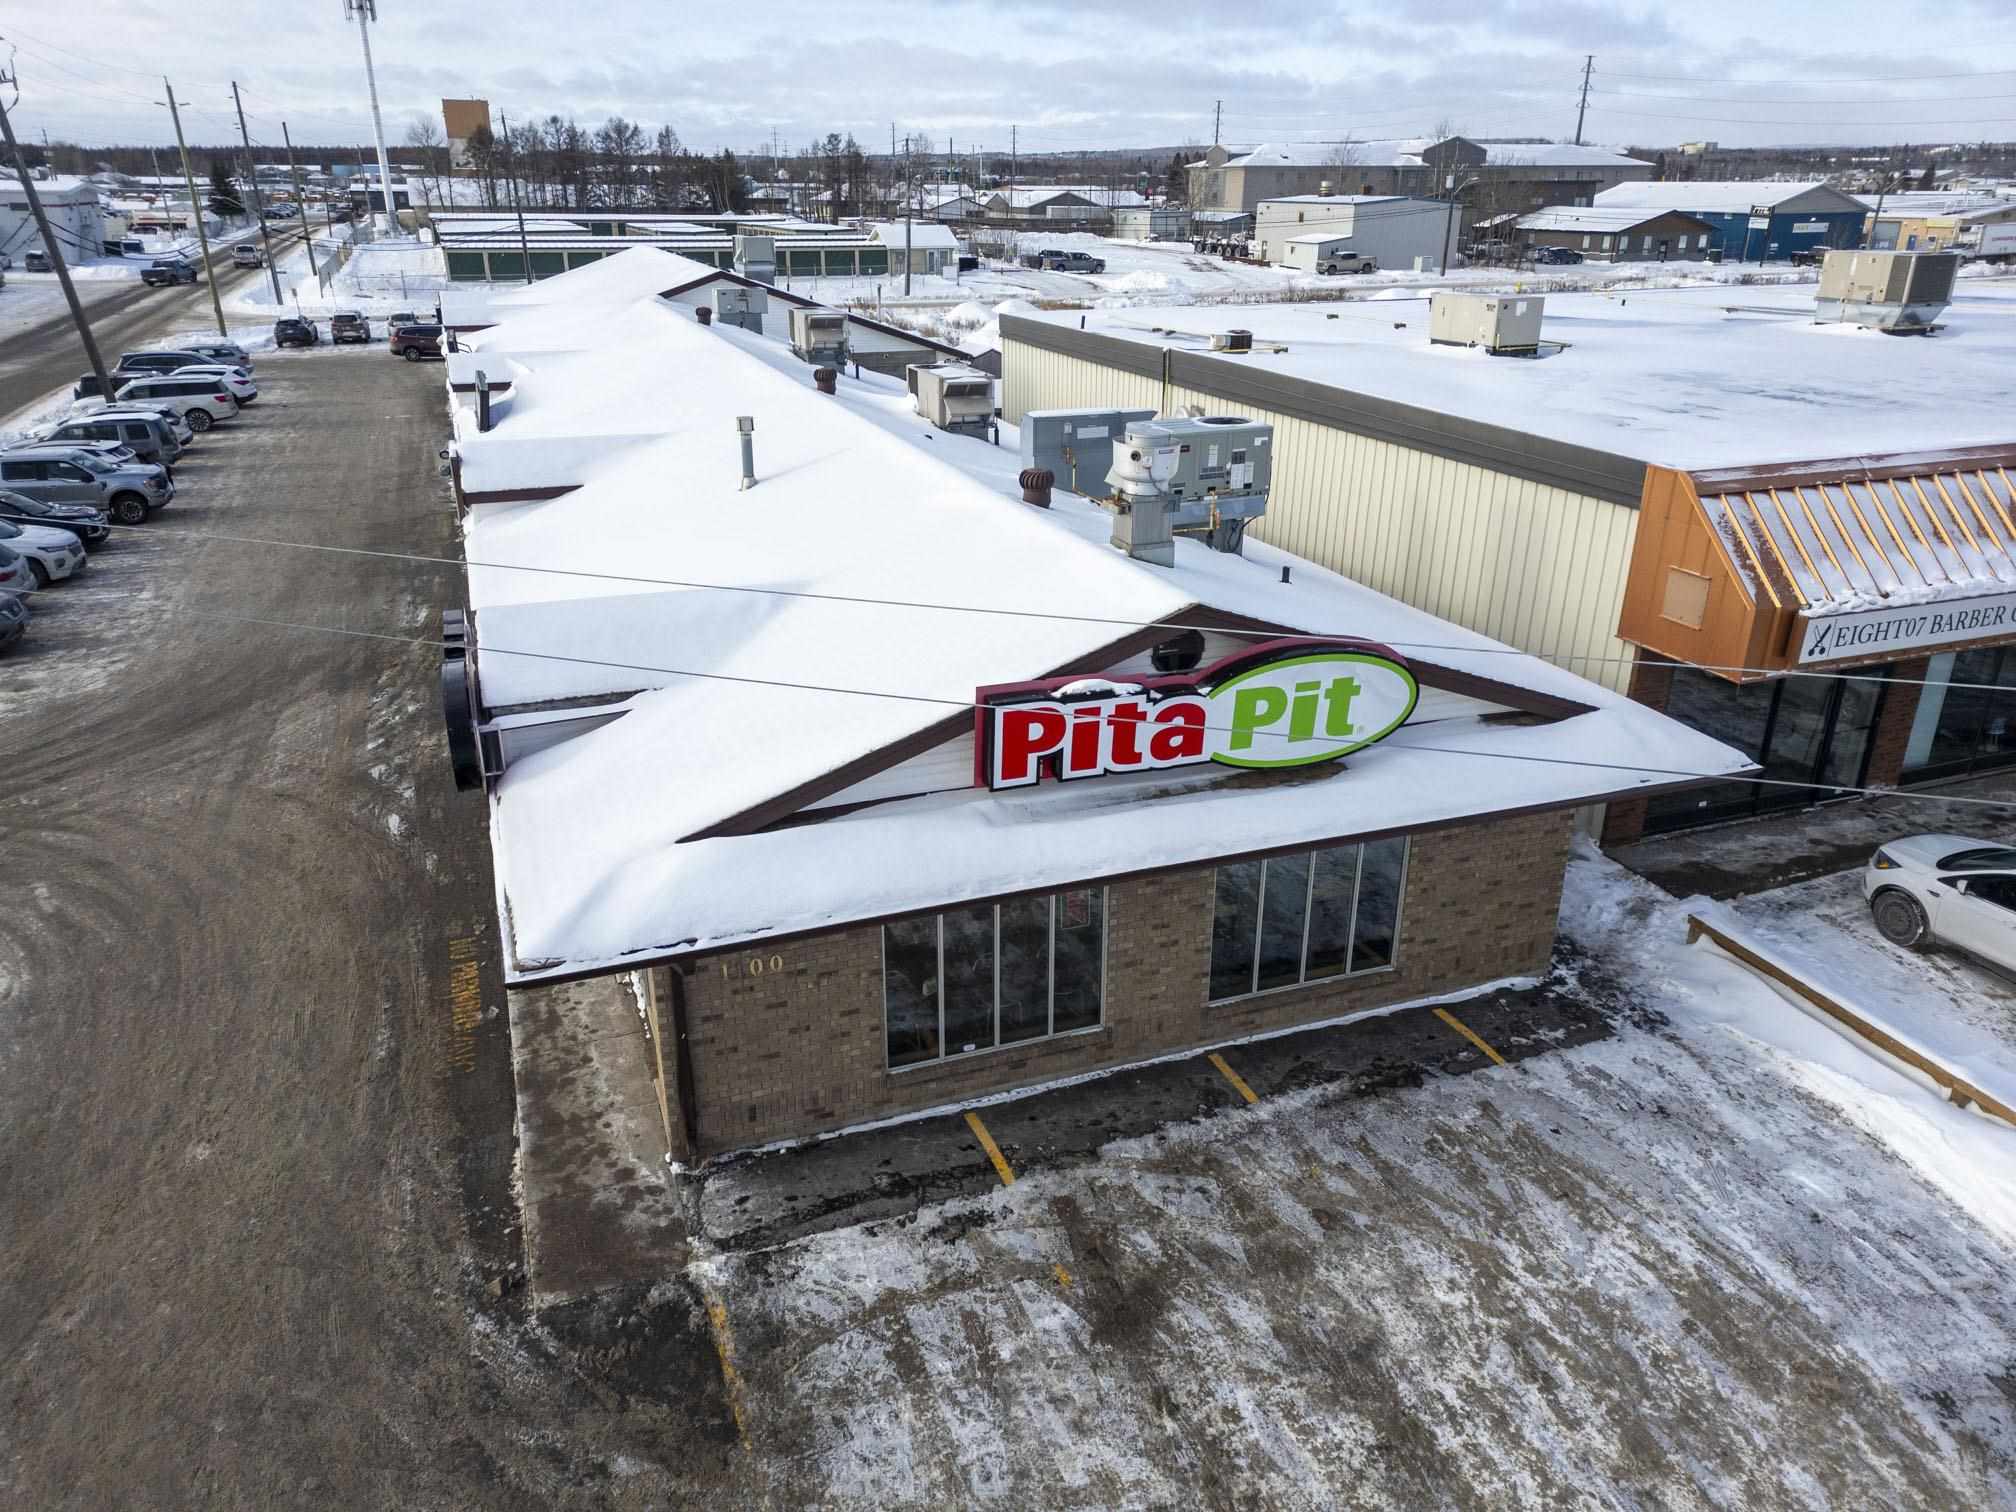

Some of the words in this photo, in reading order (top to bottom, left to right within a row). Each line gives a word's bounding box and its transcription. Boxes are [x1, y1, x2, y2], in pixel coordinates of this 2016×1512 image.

[1834, 616, 1928, 648] EIGHT07
[1929, 605, 2007, 634] BARBER
[1000, 701, 1208, 782] Pita
[1229, 676, 1362, 751] Pit
